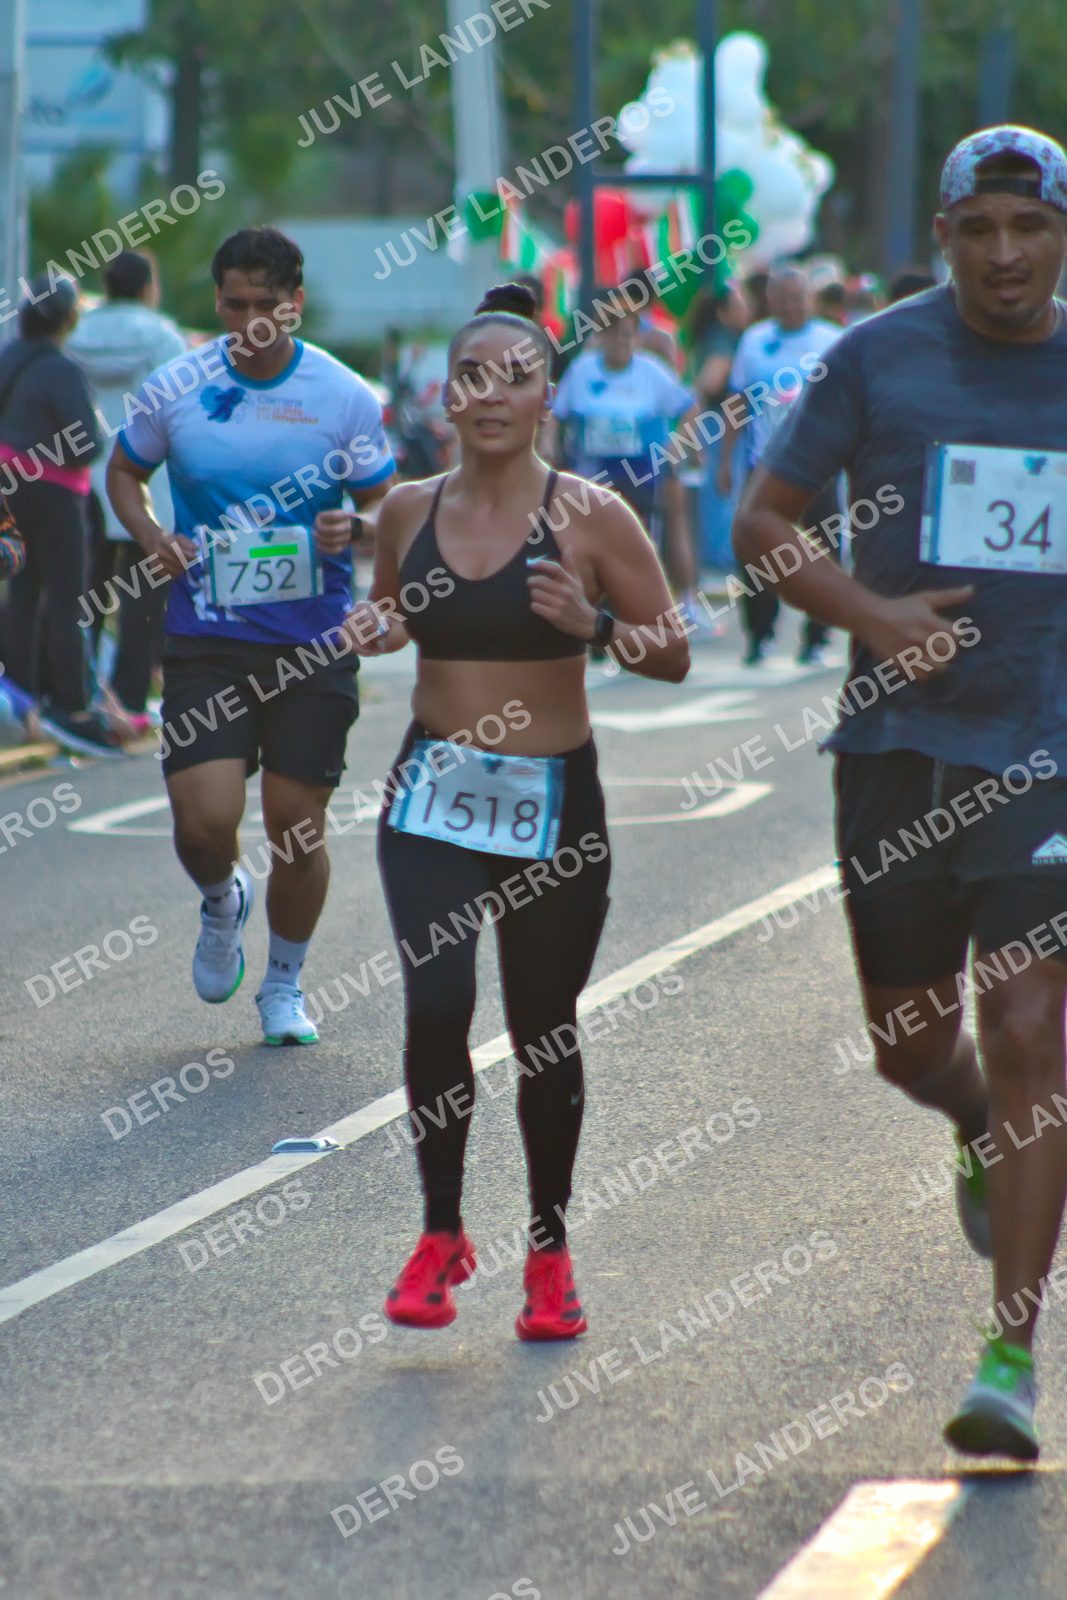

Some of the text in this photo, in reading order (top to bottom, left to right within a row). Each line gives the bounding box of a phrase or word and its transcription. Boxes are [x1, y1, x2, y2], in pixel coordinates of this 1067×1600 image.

[984, 500, 1052, 554] 34
[228, 559, 297, 594] 752
[423, 781, 540, 843] 1518
